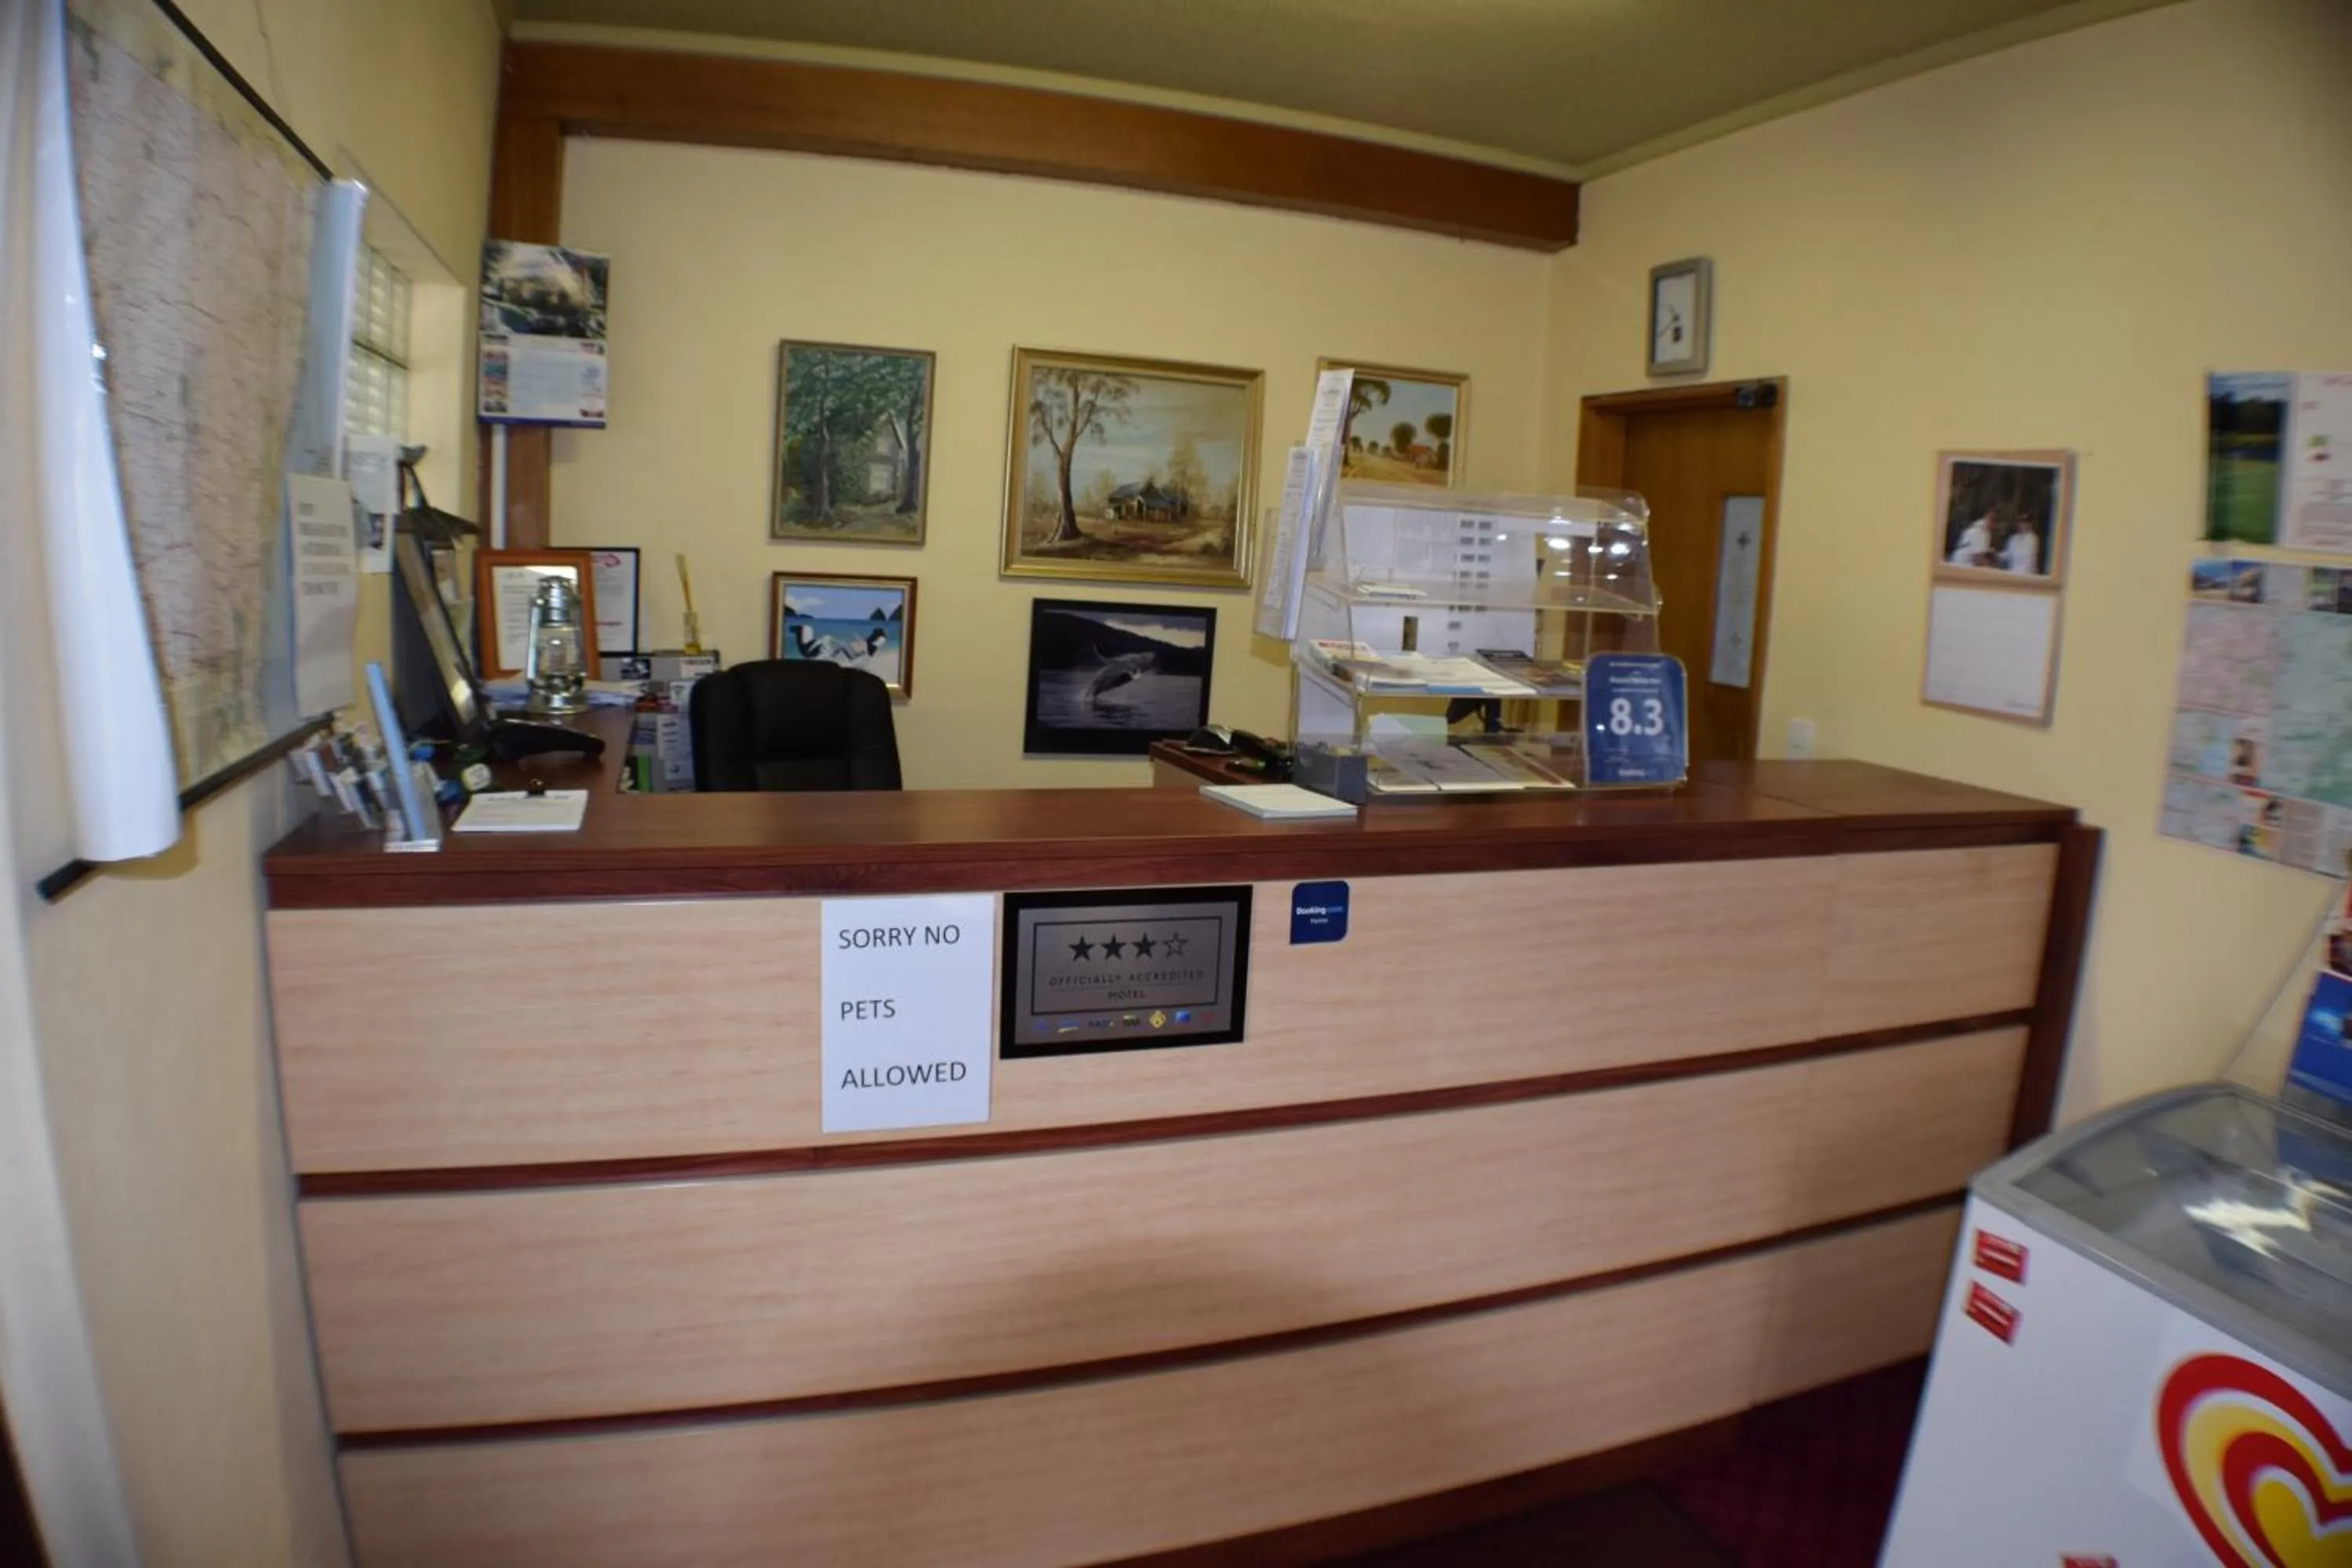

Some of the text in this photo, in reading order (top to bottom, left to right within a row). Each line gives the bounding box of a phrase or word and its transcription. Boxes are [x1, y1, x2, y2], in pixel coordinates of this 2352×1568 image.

[1610, 698, 1664, 735] 8.3
[838, 924, 960, 950] SORRY NO
[1049, 968, 1204, 986] OFFICIALLY ACCREDITED
[840, 999, 896, 1021] PETS
[841, 1062, 967, 1090] ALLOWED
